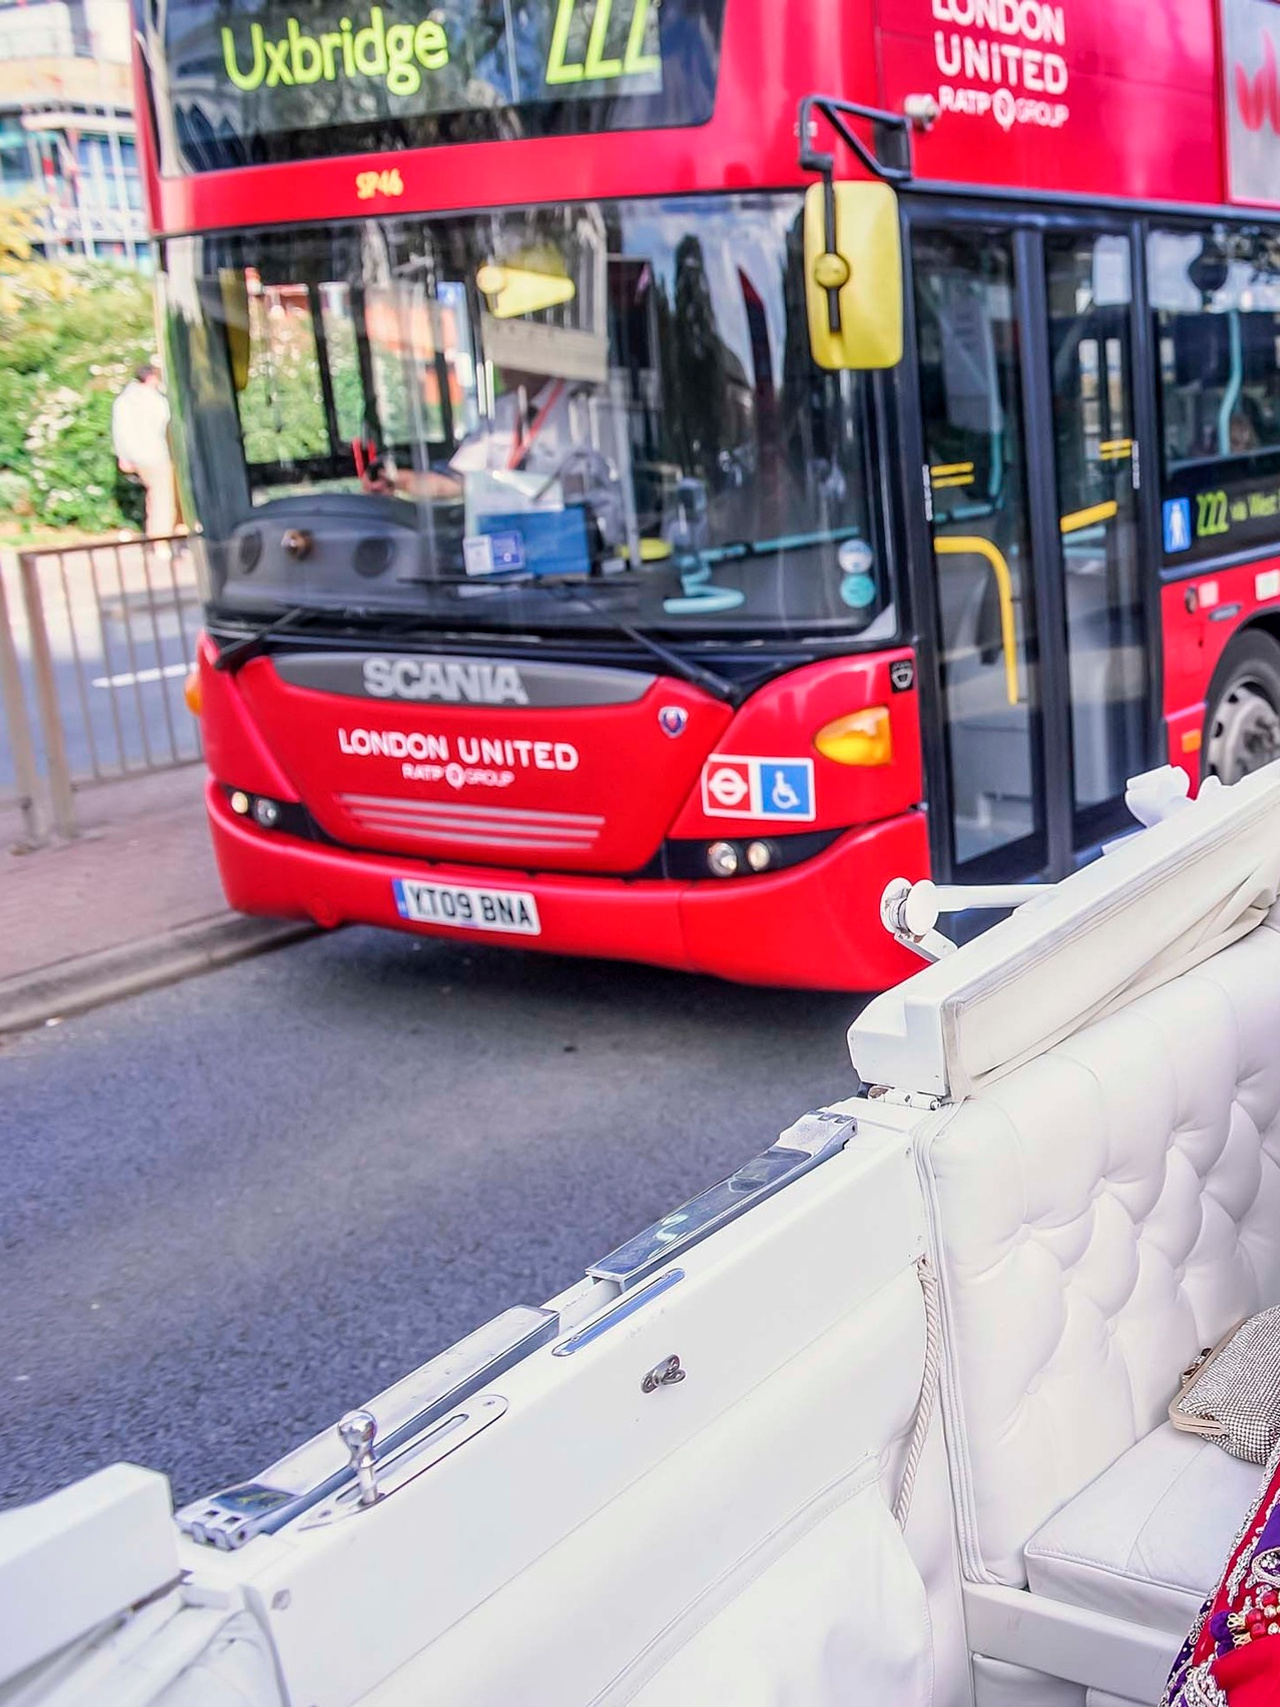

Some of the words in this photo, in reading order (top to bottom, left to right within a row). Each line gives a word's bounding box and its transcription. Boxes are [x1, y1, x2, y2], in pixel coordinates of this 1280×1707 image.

[932, 0, 1066, 46] LONDON
[221, 5, 449, 96] Uxbridge
[934, 30, 1068, 95] UNITED
[938, 85, 991, 116] RATP
[1016, 97, 1069, 128] GROUP
[362, 657, 529, 705] SCANIA
[338, 728, 449, 761] LONDON
[457, 736, 579, 771] UNITED
[402, 763, 444, 782] RATP
[465, 770, 515, 788] GROUP
[480, 894, 533, 928] BNA
